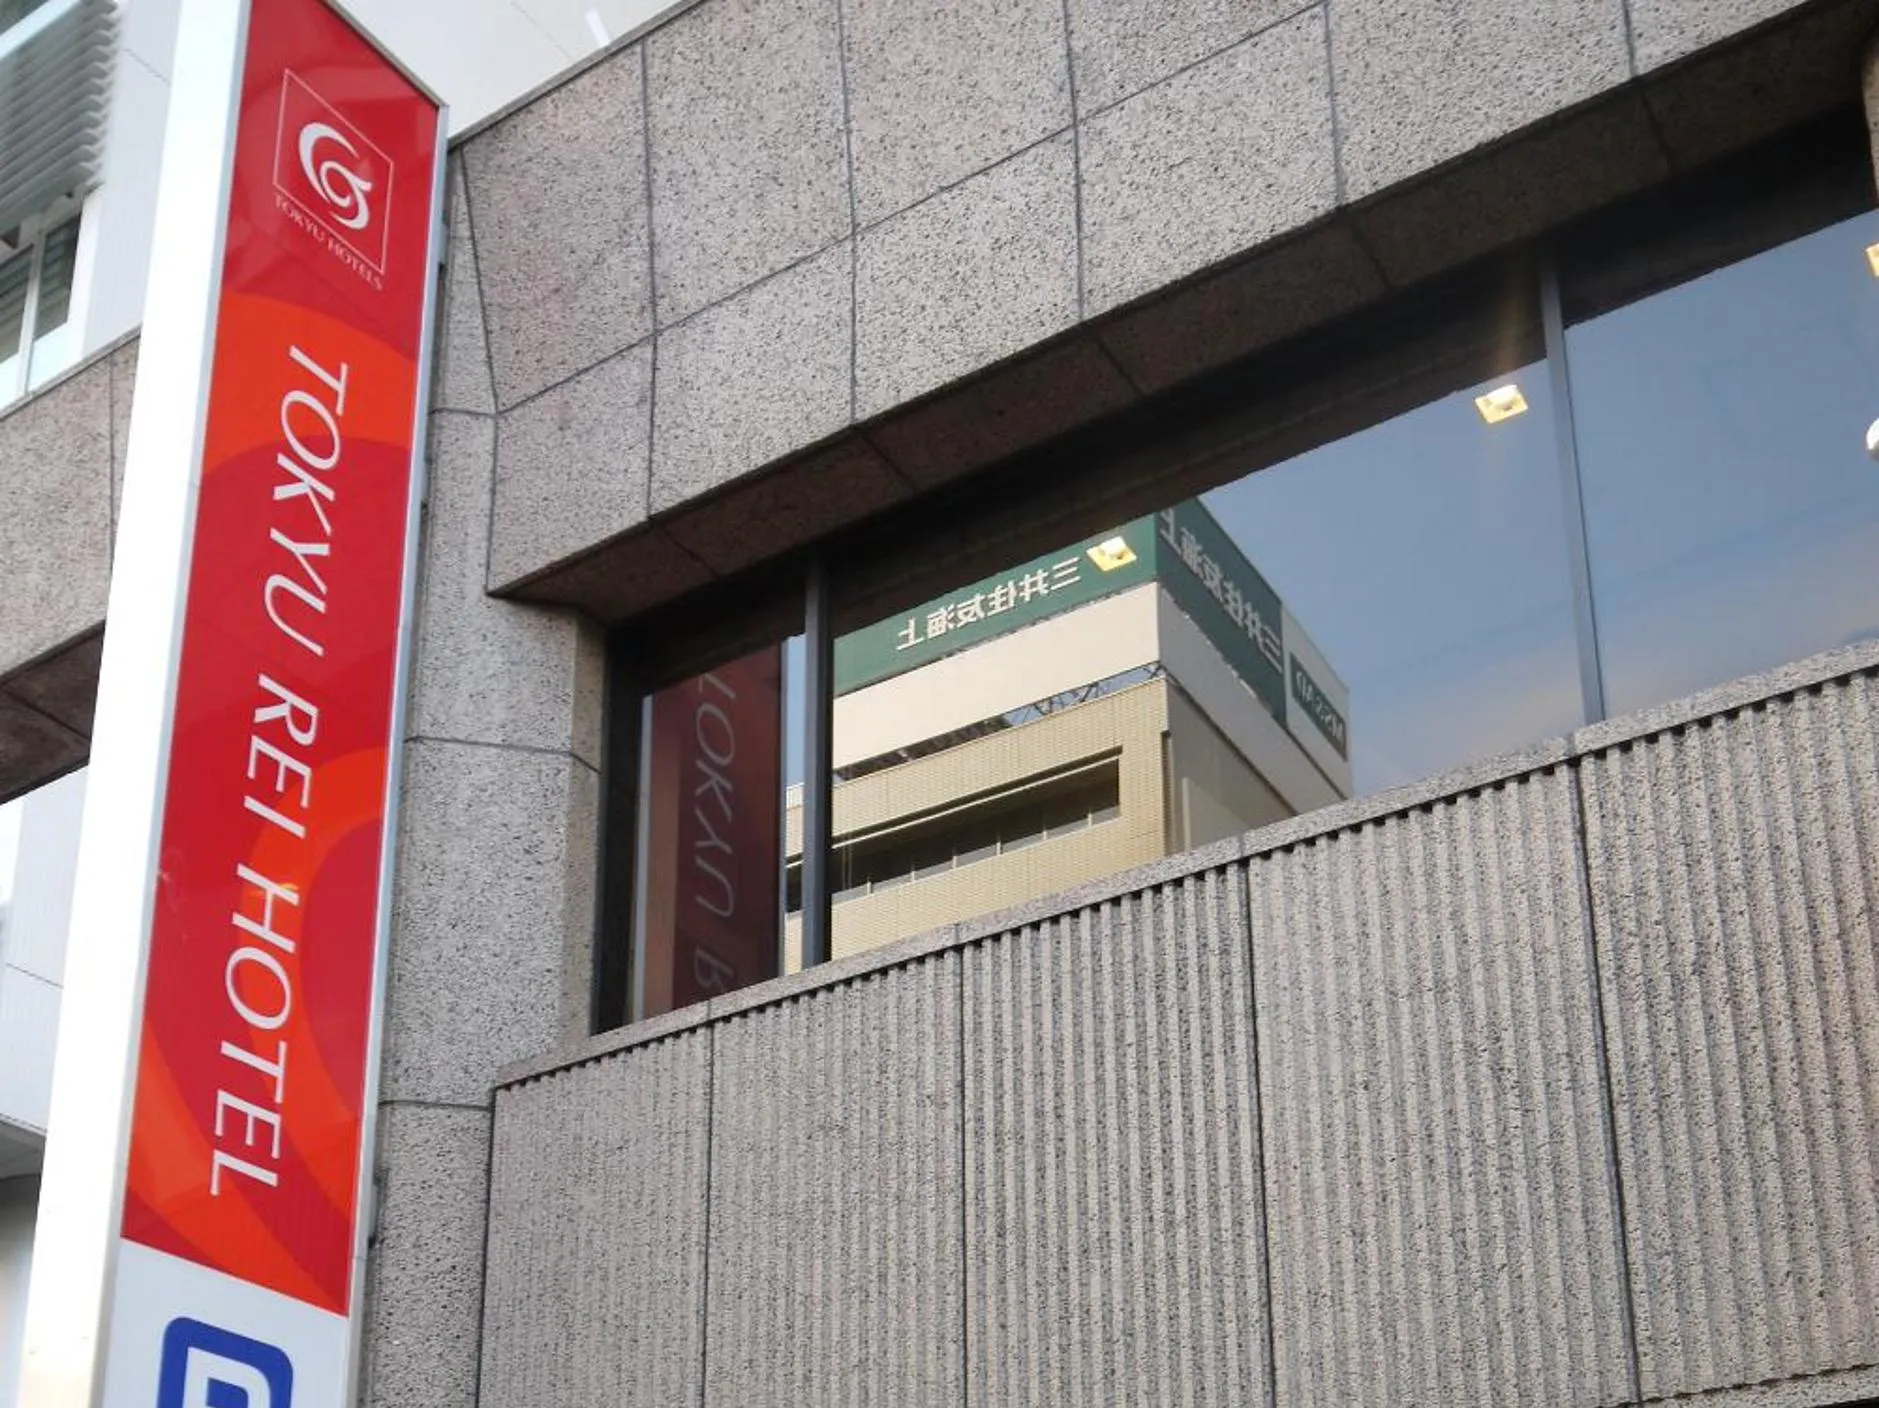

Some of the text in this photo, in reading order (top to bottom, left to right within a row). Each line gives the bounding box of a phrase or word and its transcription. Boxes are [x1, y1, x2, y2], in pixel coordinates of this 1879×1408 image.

[274, 192, 383, 291] TOKYU HOTELS
[210, 345, 348, 1197] TOKYU REI HOTEL
